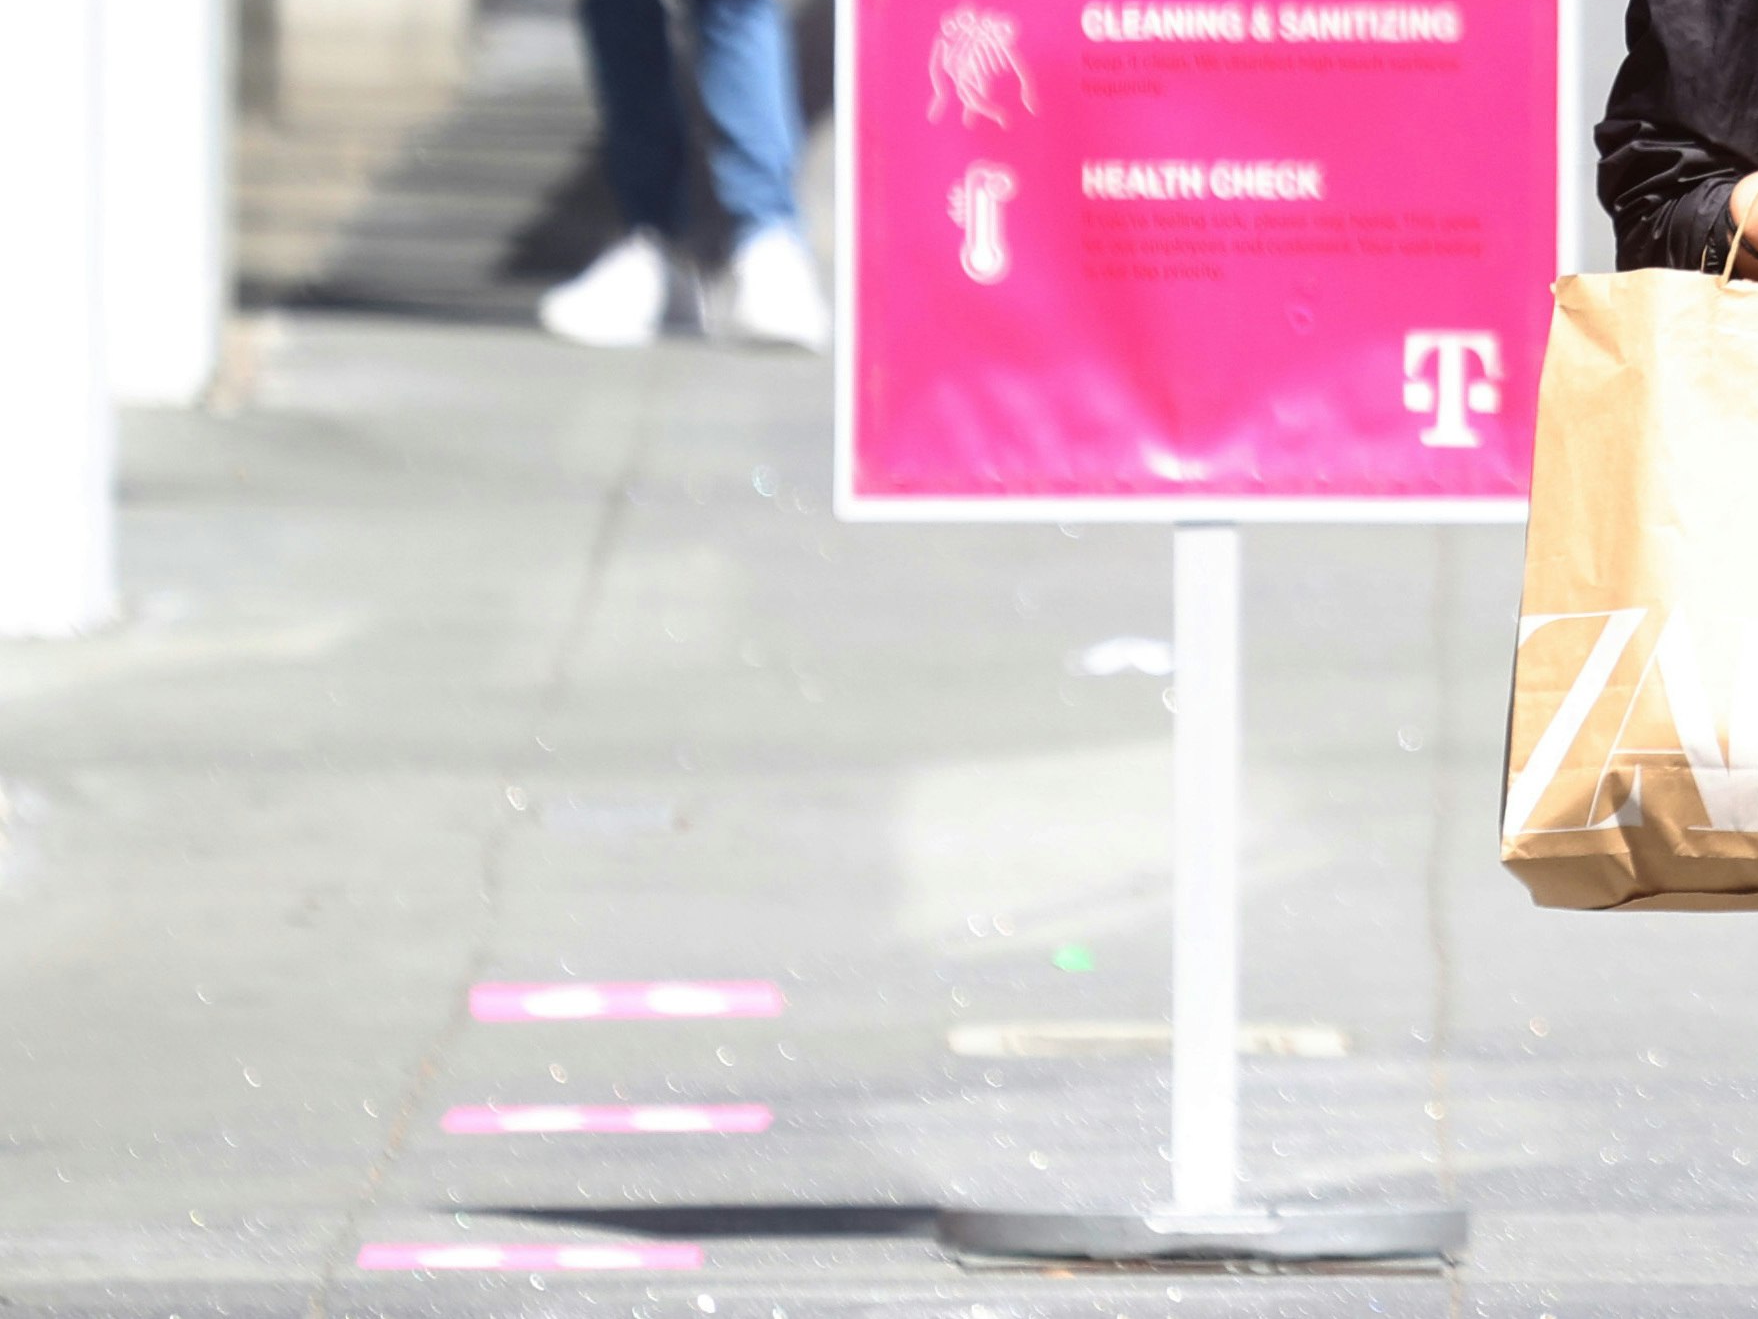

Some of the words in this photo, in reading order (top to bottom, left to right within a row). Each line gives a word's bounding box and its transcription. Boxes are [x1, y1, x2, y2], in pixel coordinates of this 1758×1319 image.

[1081, 1, 1245, 42] CLEANING
[1249, 1, 1275, 42] &
[1278, 2, 1461, 42] SANITIZING
[1081, 161, 1203, 200] HEALTH
[1207, 160, 1324, 200] CHECK
[1403, 330, 1500, 448] T
